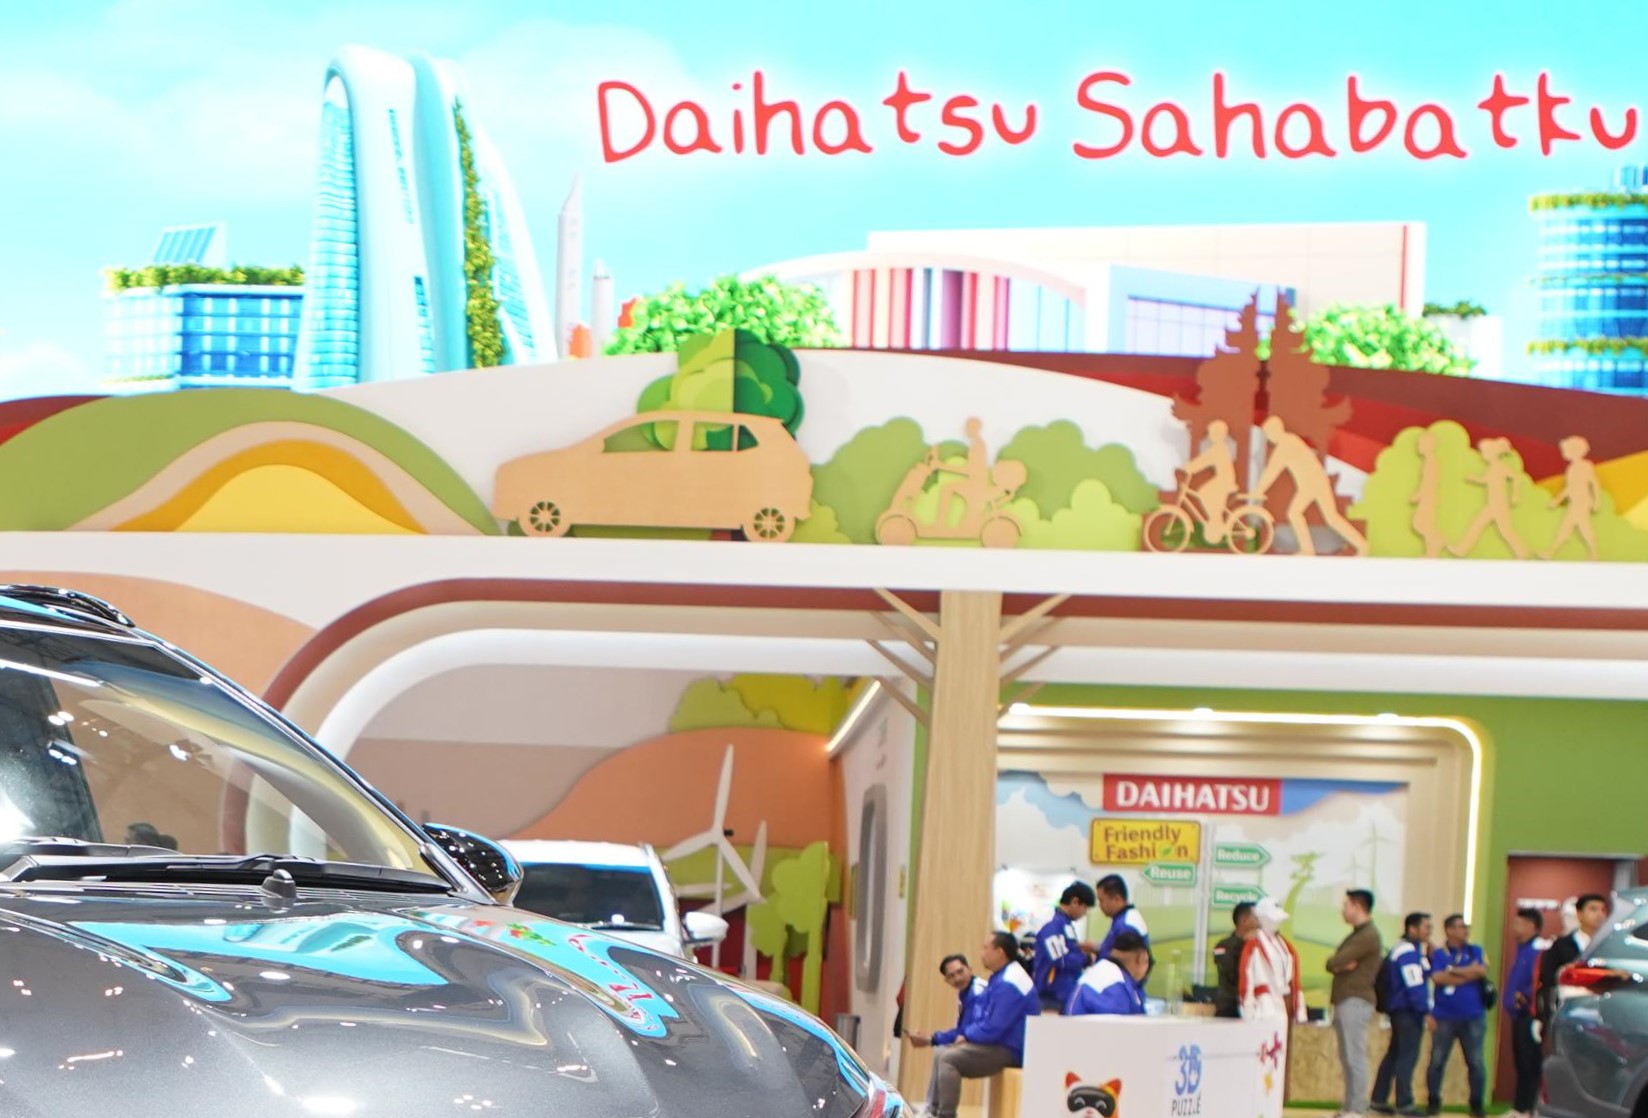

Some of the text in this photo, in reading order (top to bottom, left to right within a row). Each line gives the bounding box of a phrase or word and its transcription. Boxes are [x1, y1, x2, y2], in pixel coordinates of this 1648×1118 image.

[596, 70, 1639, 164] Daihatsu Sahabatku
[1116, 781, 1270, 811] DAIHATSU
[1104, 825, 1181, 843] Friendly
[1218, 849, 1260, 861] Reduce
[1151, 866, 1192, 880] Reuse
[1216, 890, 1259, 903] Recycle
